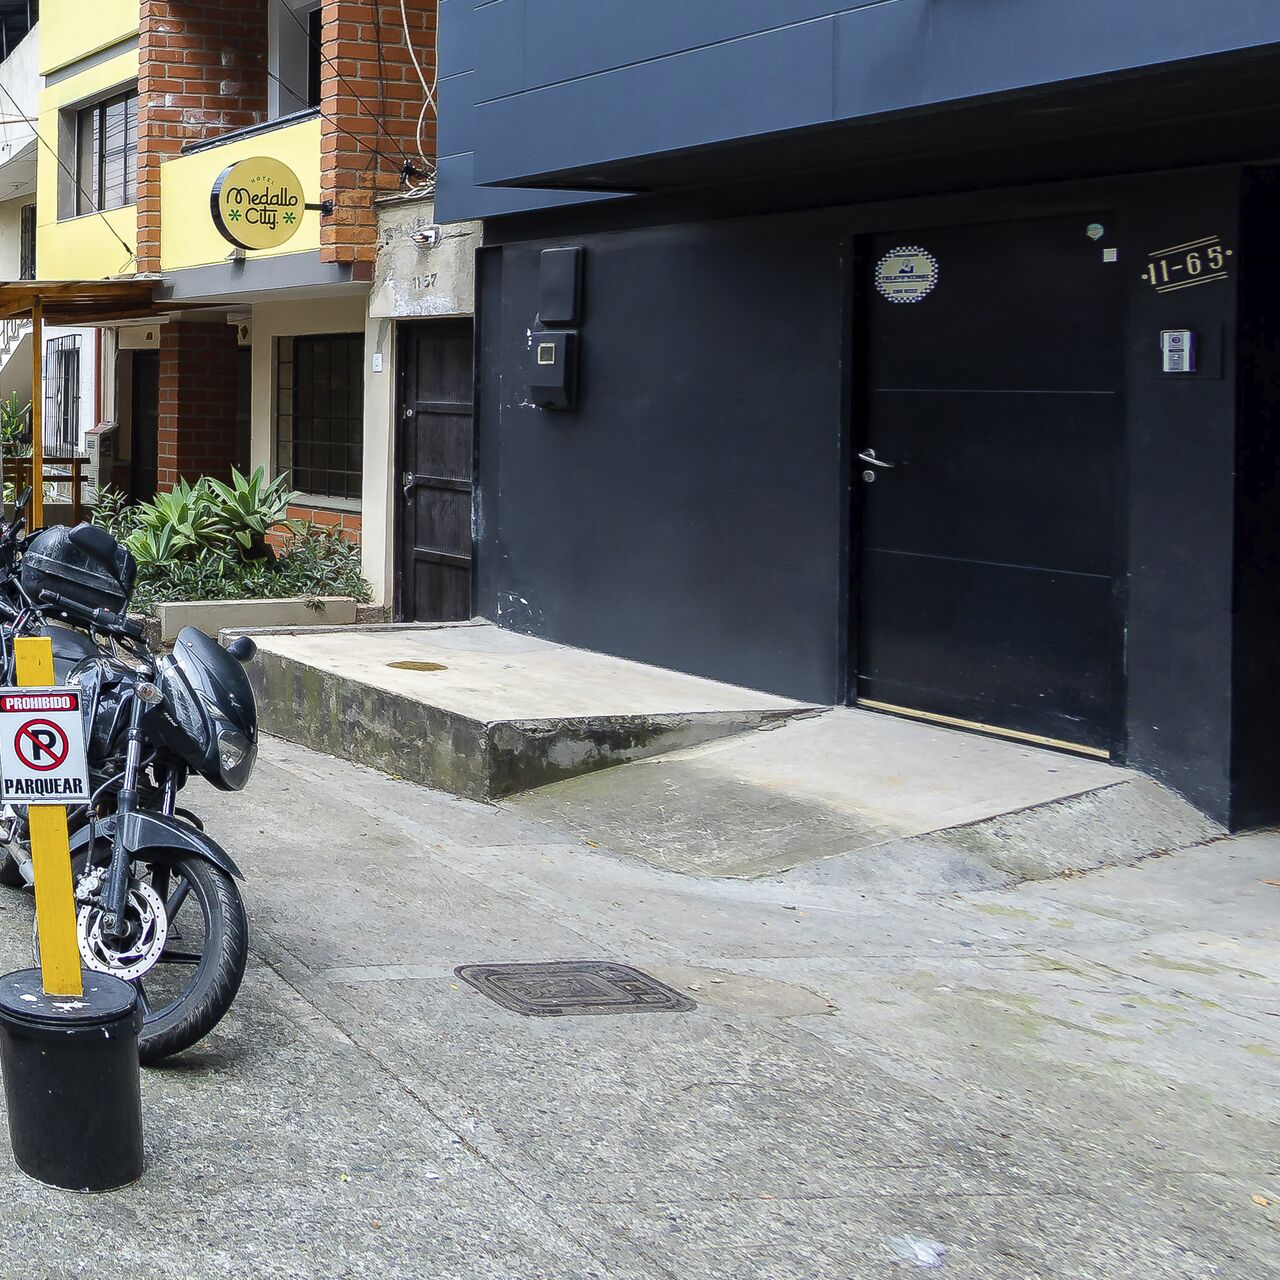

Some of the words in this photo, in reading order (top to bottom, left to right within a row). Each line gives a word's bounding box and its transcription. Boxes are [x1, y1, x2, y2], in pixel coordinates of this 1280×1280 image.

[251, 176, 276, 185] HOTEL
[227, 187, 298, 206] Medallo
[1147, 246, 1224, 285] 11-65
[5, 696, 71, 710] PROHIBIDO
[4, 778, 83, 796] PARQUEAR
